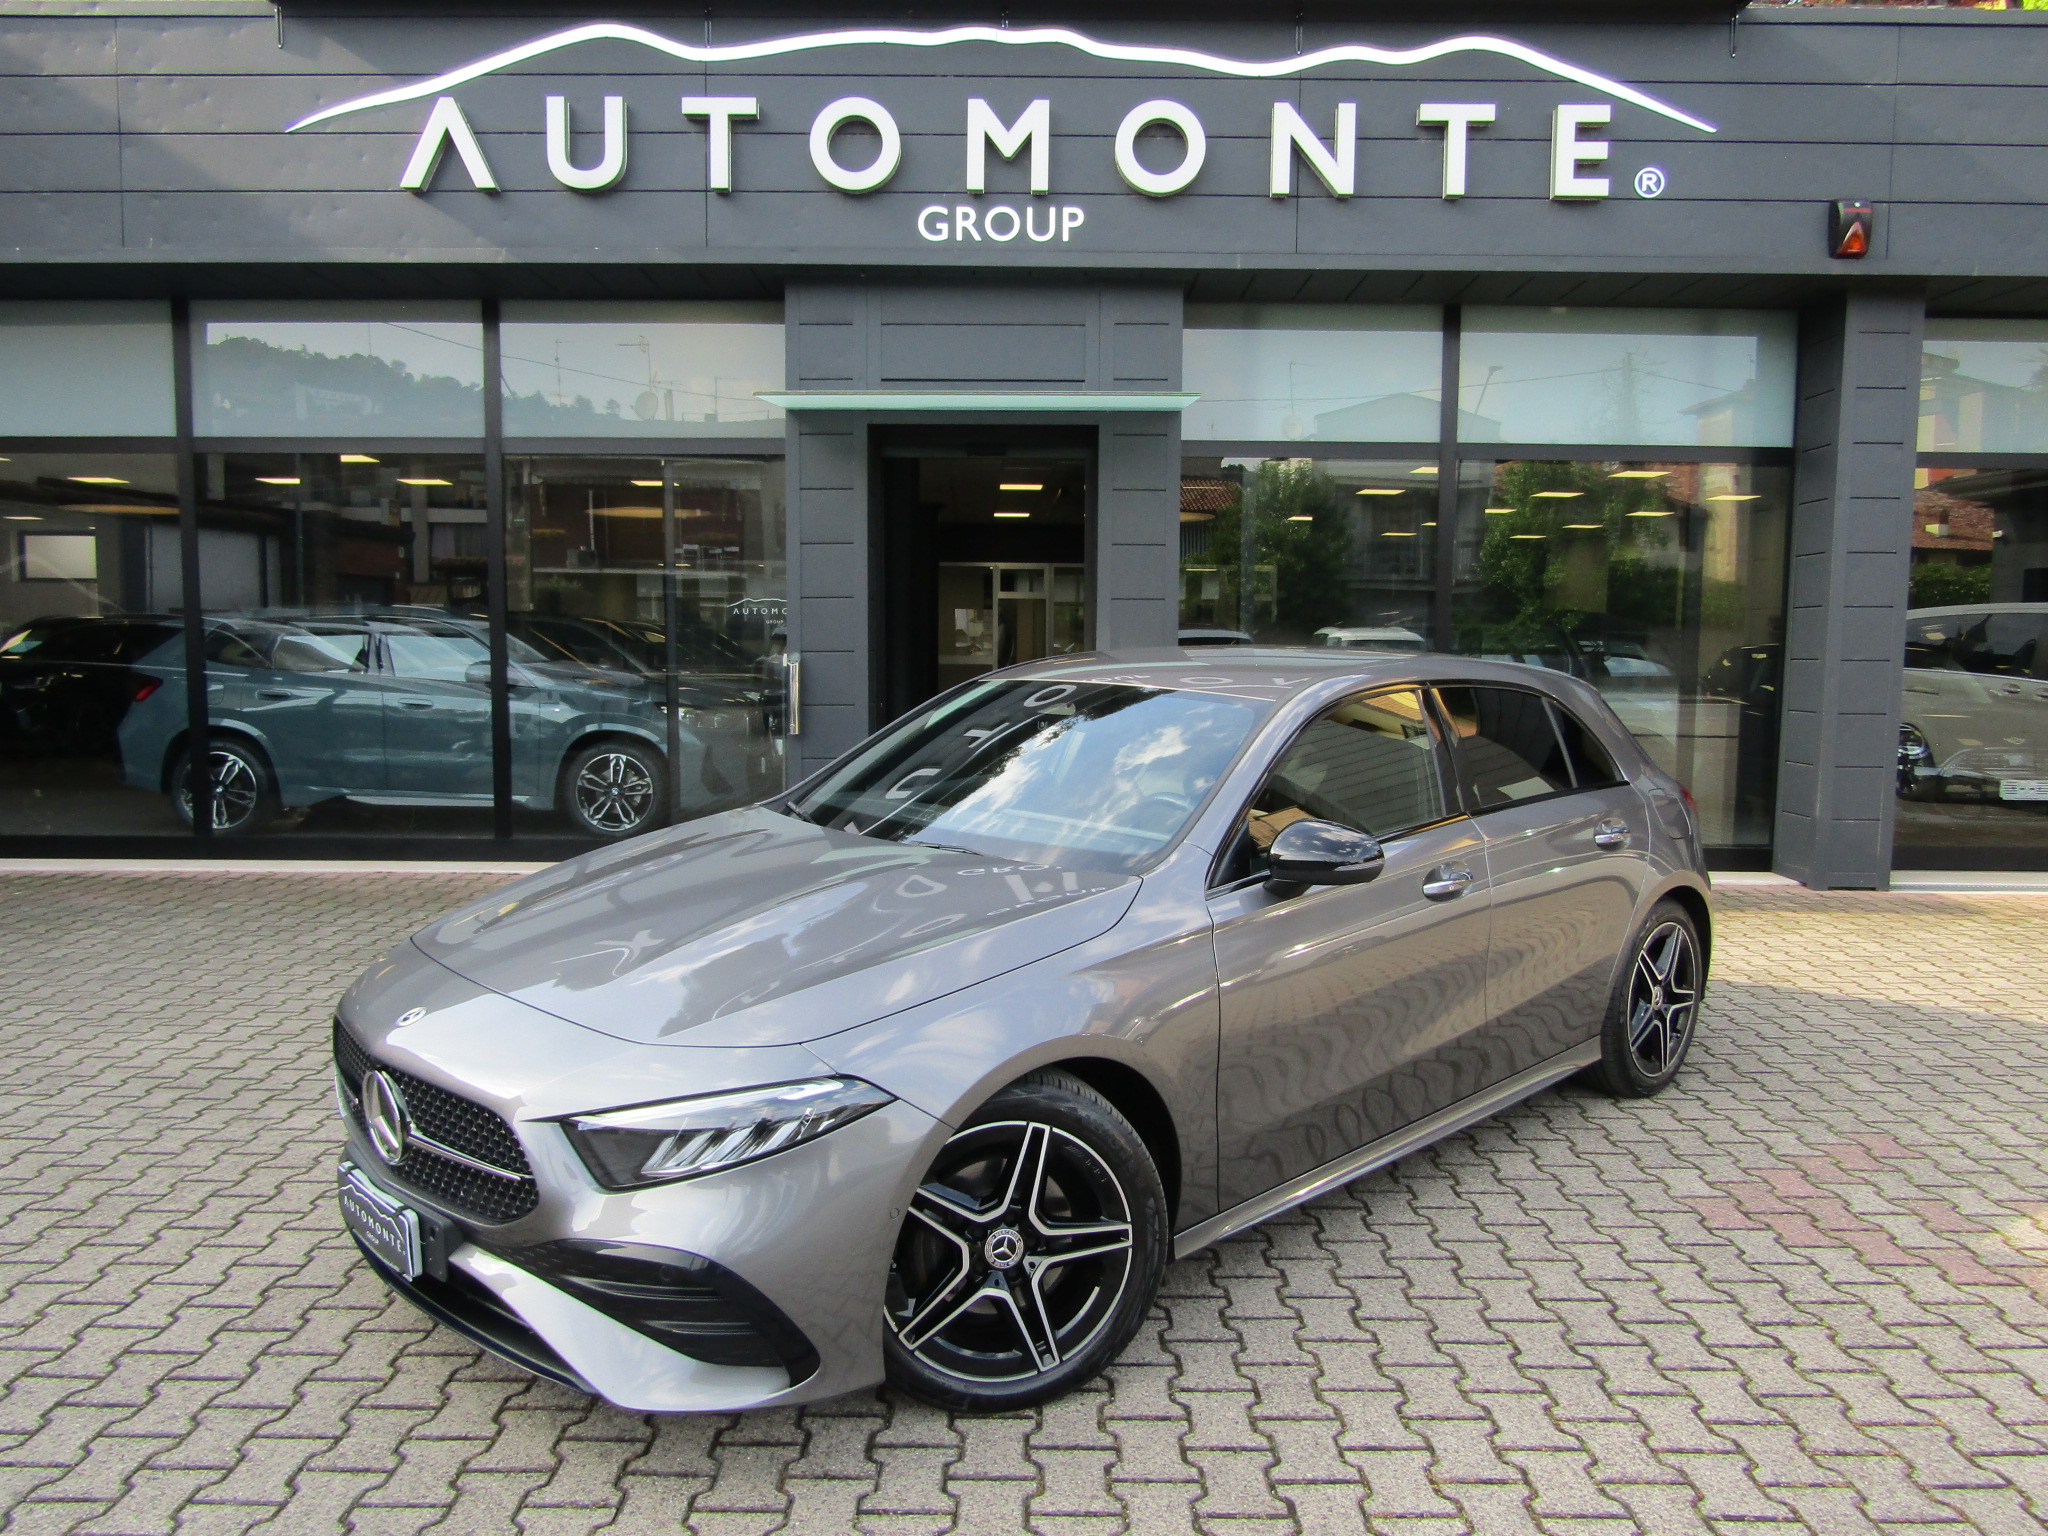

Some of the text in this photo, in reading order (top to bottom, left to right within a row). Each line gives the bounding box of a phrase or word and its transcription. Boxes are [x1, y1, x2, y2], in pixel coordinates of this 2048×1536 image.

[400, 96, 1612, 200] AUTOMONTE
[917, 205, 1085, 242] GROUP
[344, 1195, 402, 1253] AUTOMONTE
